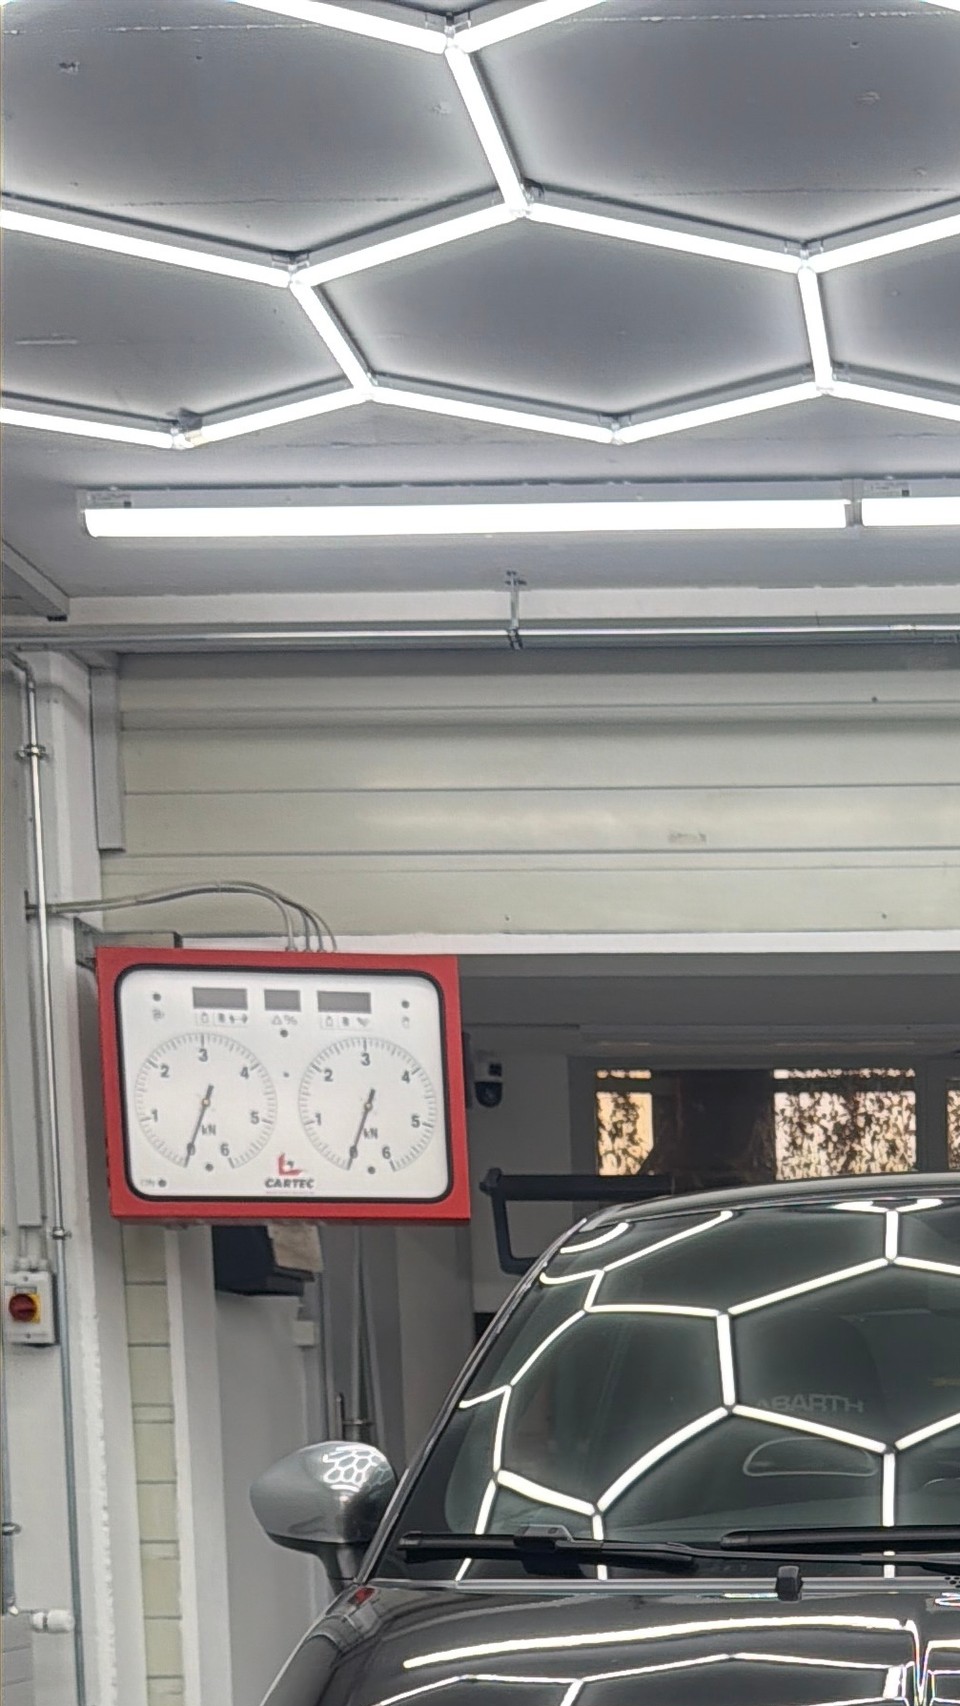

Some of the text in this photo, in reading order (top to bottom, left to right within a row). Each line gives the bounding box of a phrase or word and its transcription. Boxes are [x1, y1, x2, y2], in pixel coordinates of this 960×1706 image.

[198, 1048, 209, 1062] 3
[360, 1052, 371, 1066] 3
[160, 1064, 170, 1078] 2
[240, 1066, 249, 1079] 4
[324, 1068, 333, 1082] 2
[401, 1070, 411, 1083] 4
[151, 1109, 159, 1122] 1
[250, 1111, 260, 1125] 5
[315, 1112, 322, 1126] 1
[410, 1115, 421, 1128] 5
[220, 1142, 230, 1157] 6
[381, 1146, 392, 1159] 6
[265, 1178, 315, 1189] CARTEC
